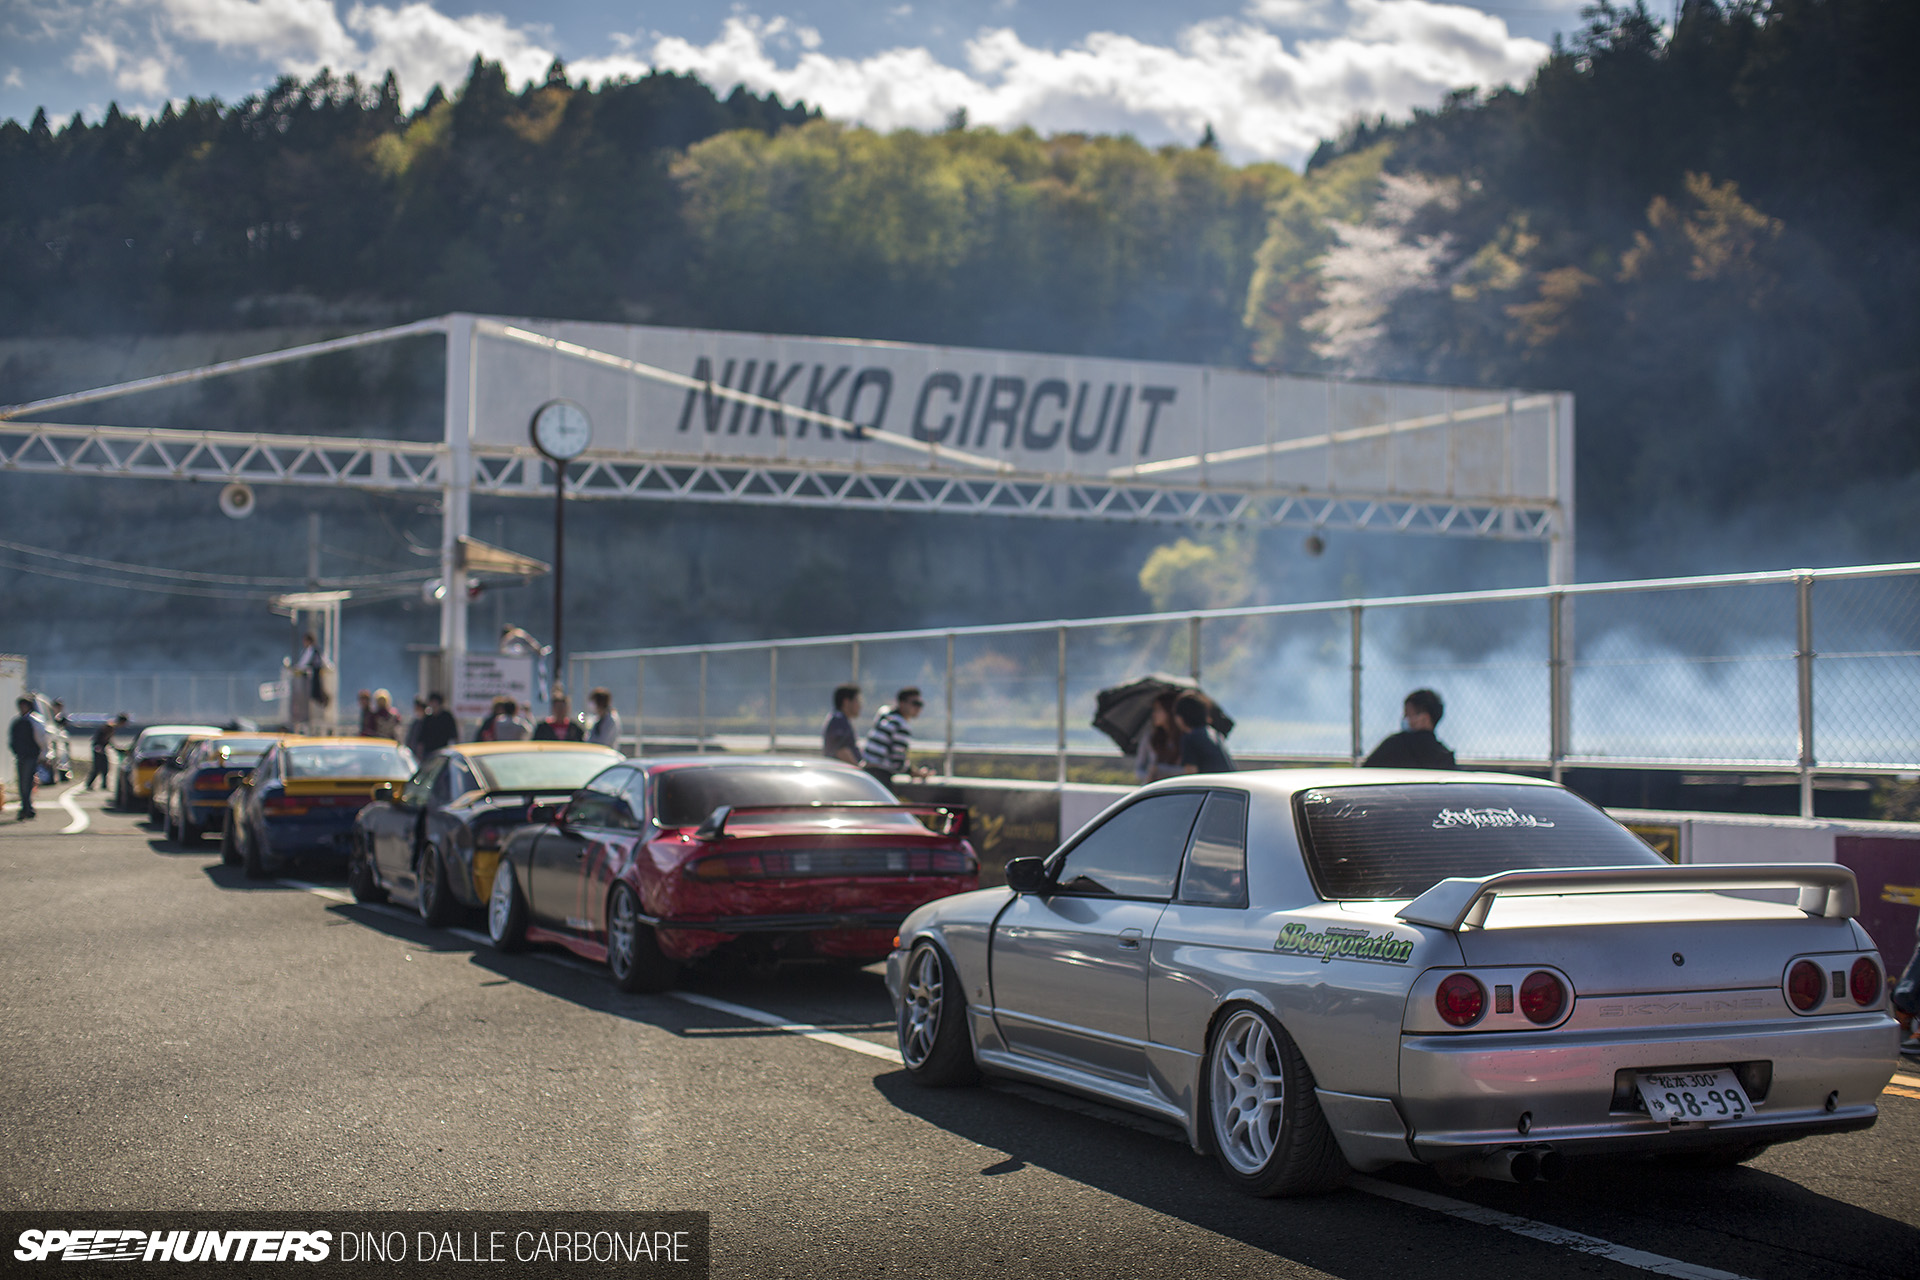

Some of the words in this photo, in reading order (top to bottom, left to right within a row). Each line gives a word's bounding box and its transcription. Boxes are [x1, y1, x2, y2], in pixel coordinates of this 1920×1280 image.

[677, 356, 894, 442] NIKKO
[912, 370, 1178, 457] CIRCUIT
[1274, 922, 1414, 963] SBcorporation
[1600, 998, 1763, 1017] SKYLINE
[1687, 1074, 1715, 1088] 300
[1665, 1089, 1746, 1118] 98-99
